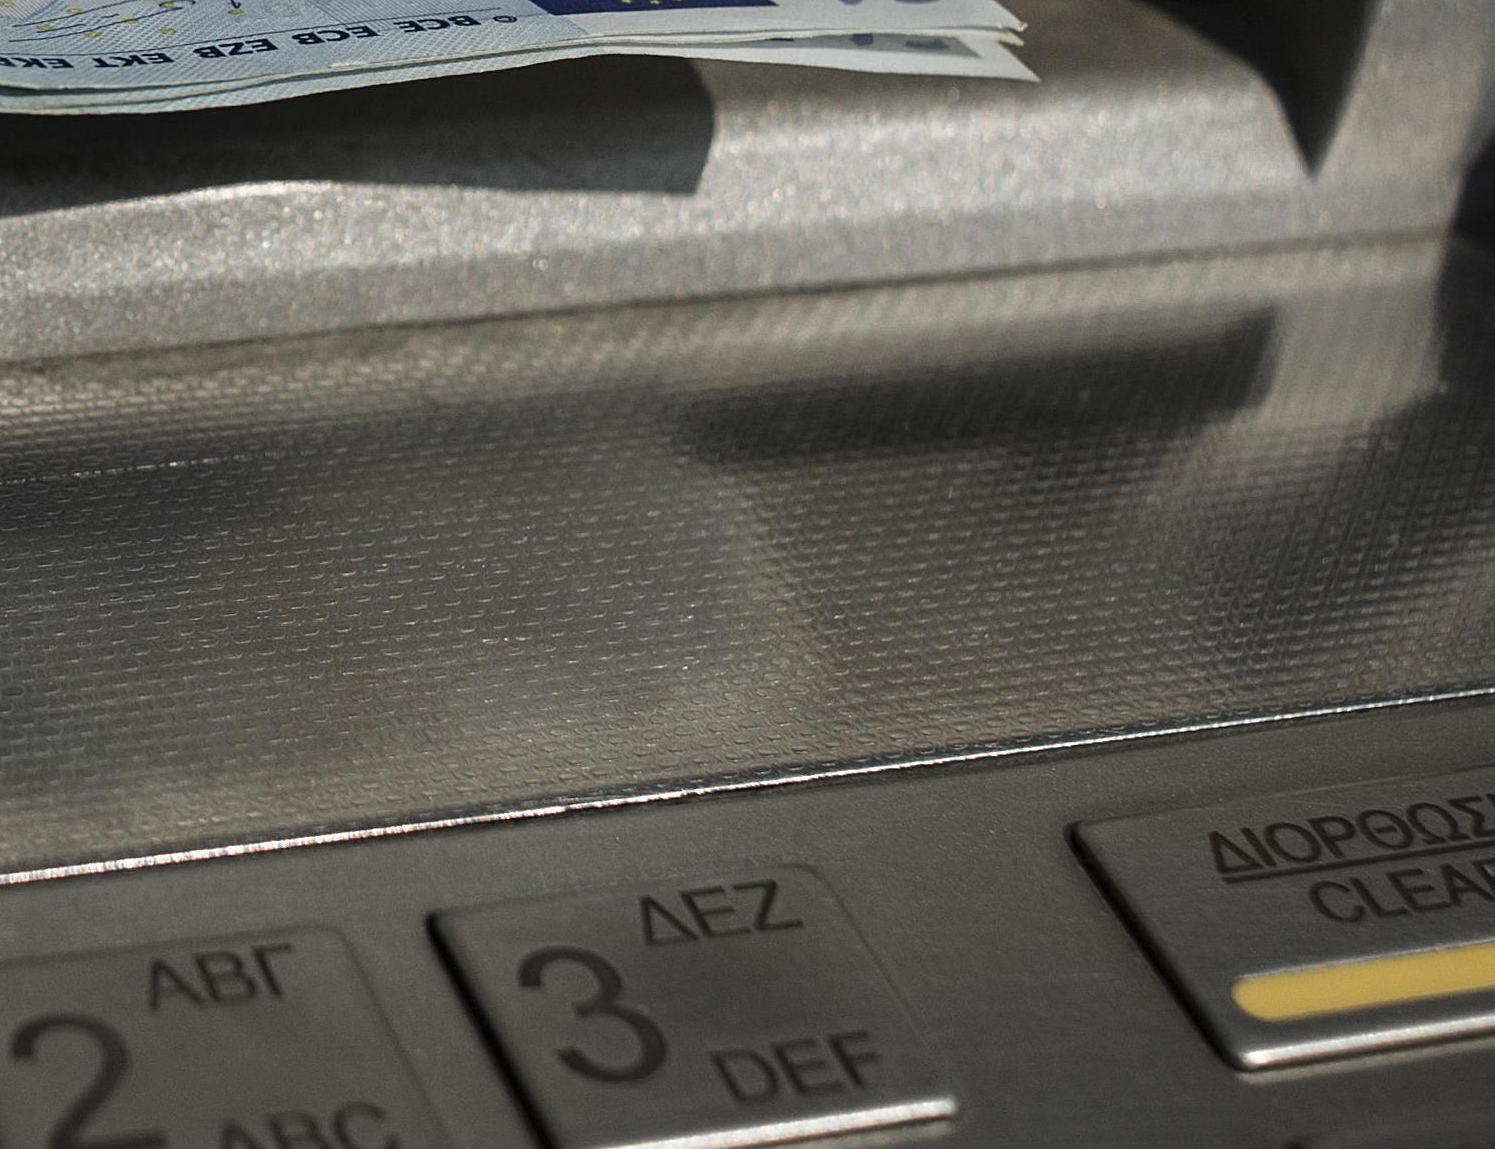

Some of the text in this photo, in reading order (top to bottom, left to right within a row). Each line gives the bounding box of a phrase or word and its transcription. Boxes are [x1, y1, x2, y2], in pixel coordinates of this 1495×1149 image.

[192, 37, 279, 60] EZB
[291, 24, 381, 46] ECB
[393, 14, 482, 33] BCE
[93, 52, 176, 69] EKT
[1208, 793, 1495, 876] ΔΙΟΡΘΩΣ
[638, 878, 804, 947] ΔΕΖ
[149, 943, 292, 1012] ΑΒΓ
[517, 944, 669, 1084] 3
[10, 1010, 170, 1149] 2
[711, 1029, 882, 1104] DEF
